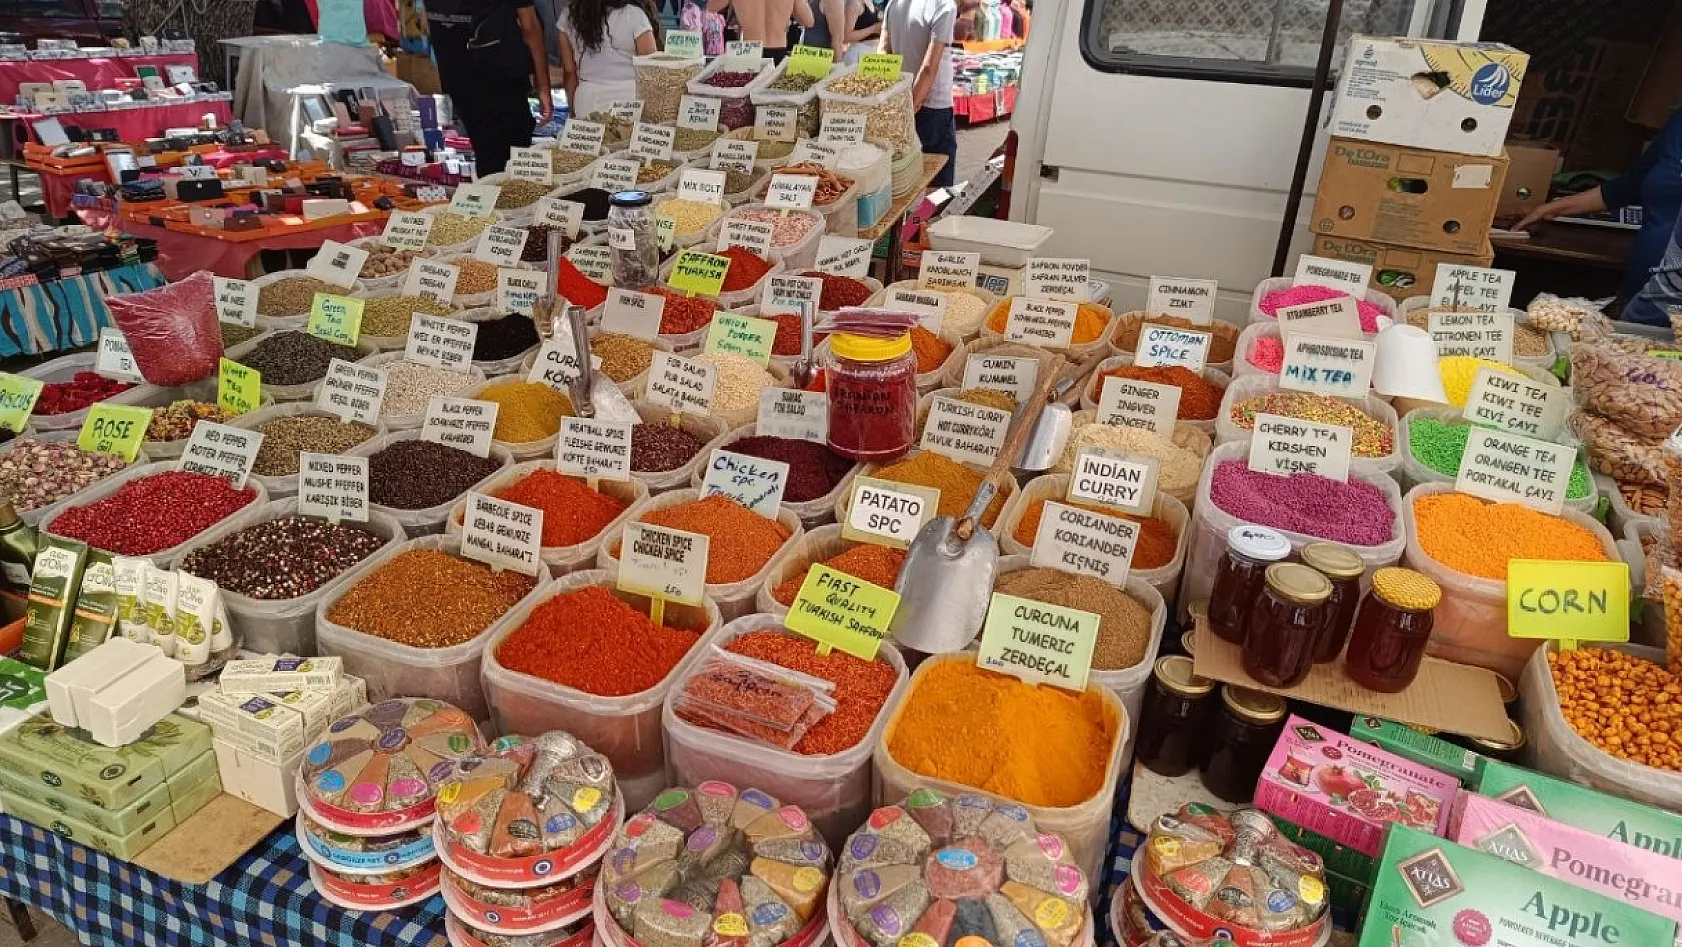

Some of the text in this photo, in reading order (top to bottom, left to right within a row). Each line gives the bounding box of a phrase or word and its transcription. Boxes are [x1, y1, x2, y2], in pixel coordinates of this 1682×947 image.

[779, 192, 798, 202] SALT
[680, 253, 729, 269] SAFFRON
[676, 266, 722, 280] TURKISH
[1348, 272, 1362, 285] TEA
[1448, 268, 1503, 286] APPLE TEA
[1158, 284, 1210, 298] CINNAMON
[1478, 286, 1499, 300] TEE
[1045, 306, 1067, 317] PEPPER
[1168, 298, 1195, 309] ZIMT
[1286, 301, 1344, 321] STRAWBERRY TEA
[418, 318, 472, 338] WHITE PEPPER
[1439, 314, 1496, 327] LEMON TEA
[443, 335, 473, 351] PFEFFER
[1147, 328, 1205, 346] OTTOMAN
[1431, 330, 1503, 343] ZITRONEN TEE
[1148, 345, 1190, 361] SPICE
[1349, 348, 1364, 362] TEA
[335, 364, 379, 383] GREEN PEPPER
[666, 357, 707, 378] FOR SALAD
[981, 359, 1016, 372] CUMIN
[679, 375, 704, 391] SALAD
[978, 373, 1019, 386] KUMMEL
[1321, 368, 1353, 385] TEA
[652, 382, 680, 398] SALATA
[781, 391, 802, 404] SUMAC
[1119, 384, 1160, 400] GINGER
[1486, 375, 1549, 403] KIWI TEA
[463, 405, 484, 417] PEPPER
[773, 402, 807, 417] FOR SALAD
[937, 401, 1005, 425] TURKISH CURRY
[1116, 398, 1157, 416] INGVER
[1481, 391, 1544, 419] KIWI TEE
[92, 417, 134, 440] ROSE
[465, 420, 490, 433] PFEFFER
[569, 422, 627, 440] MEATBALL SPICE
[937, 420, 951, 432] HOT
[1258, 422, 1307, 439] CHERRY
[205, 428, 247, 448] RED PEPPER
[926, 430, 955, 446] TAVUK
[190, 443, 217, 459] ROTER
[1267, 440, 1328, 459] KIRSHEN
[1482, 436, 1557, 465] ORANGE TEA
[308, 461, 362, 477] MIXED PEPPER
[713, 456, 779, 485] Chicken
[1473, 452, 1557, 485] ORANGEN TEE
[335, 480, 365, 494] PFEFFER
[1078, 478, 1139, 502] CURRY
[1464, 469, 1522, 495] PORTAKAL
[860, 489, 920, 517] PATATO
[476, 498, 533, 527] BARBECUE SPICE
[868, 514, 902, 534] SPC
[1059, 509, 1134, 540] CORIANDER
[466, 534, 495, 552] MANGAL
[640, 527, 693, 551] CHICKEN SPICE
[1053, 528, 1129, 559] KORIANDER
[633, 540, 685, 563] CHICKEN SPICE
[816, 571, 860, 596] FIRST
[825, 592, 877, 619] QUALITY
[1518, 586, 1608, 615] CORN
[797, 598, 844, 626] TURKISH
[1013, 604, 1081, 634] CURCUNA
[1010, 626, 1076, 656] TUMERIC
[999, 647, 1071, 680] ZERDEÇAL
[1336, 739, 1446, 790] Pomegranate
[1520, 890, 1620, 944] Apple
